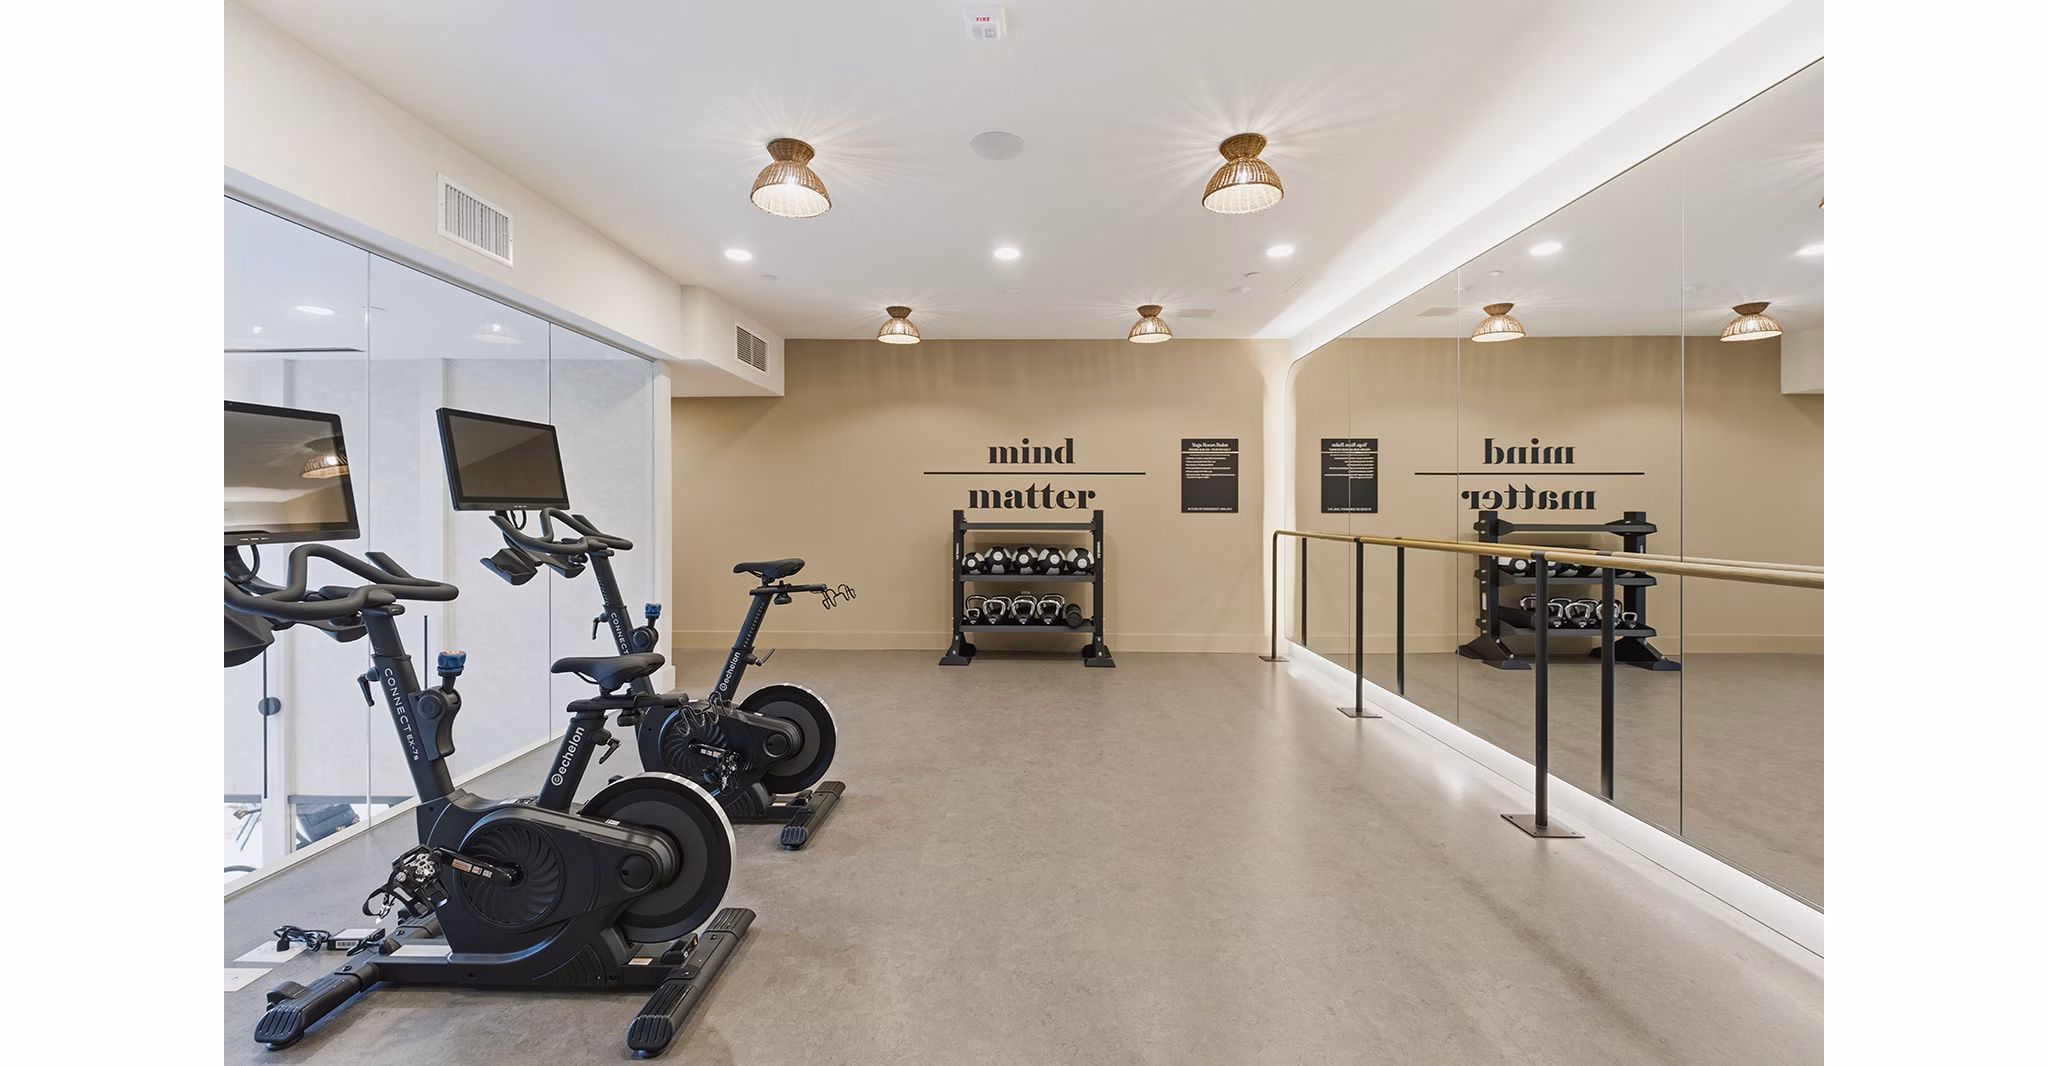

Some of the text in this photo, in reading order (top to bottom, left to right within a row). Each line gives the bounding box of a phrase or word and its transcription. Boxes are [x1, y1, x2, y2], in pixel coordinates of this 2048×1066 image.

[988, 438, 1075, 464] mind
[968, 483, 1096, 509] matter
[611, 612, 630, 655] CONNECT
[724, 651, 741, 684] echelon
[384, 667, 412, 732] CONNECT
[558, 726, 585, 775] echelon
